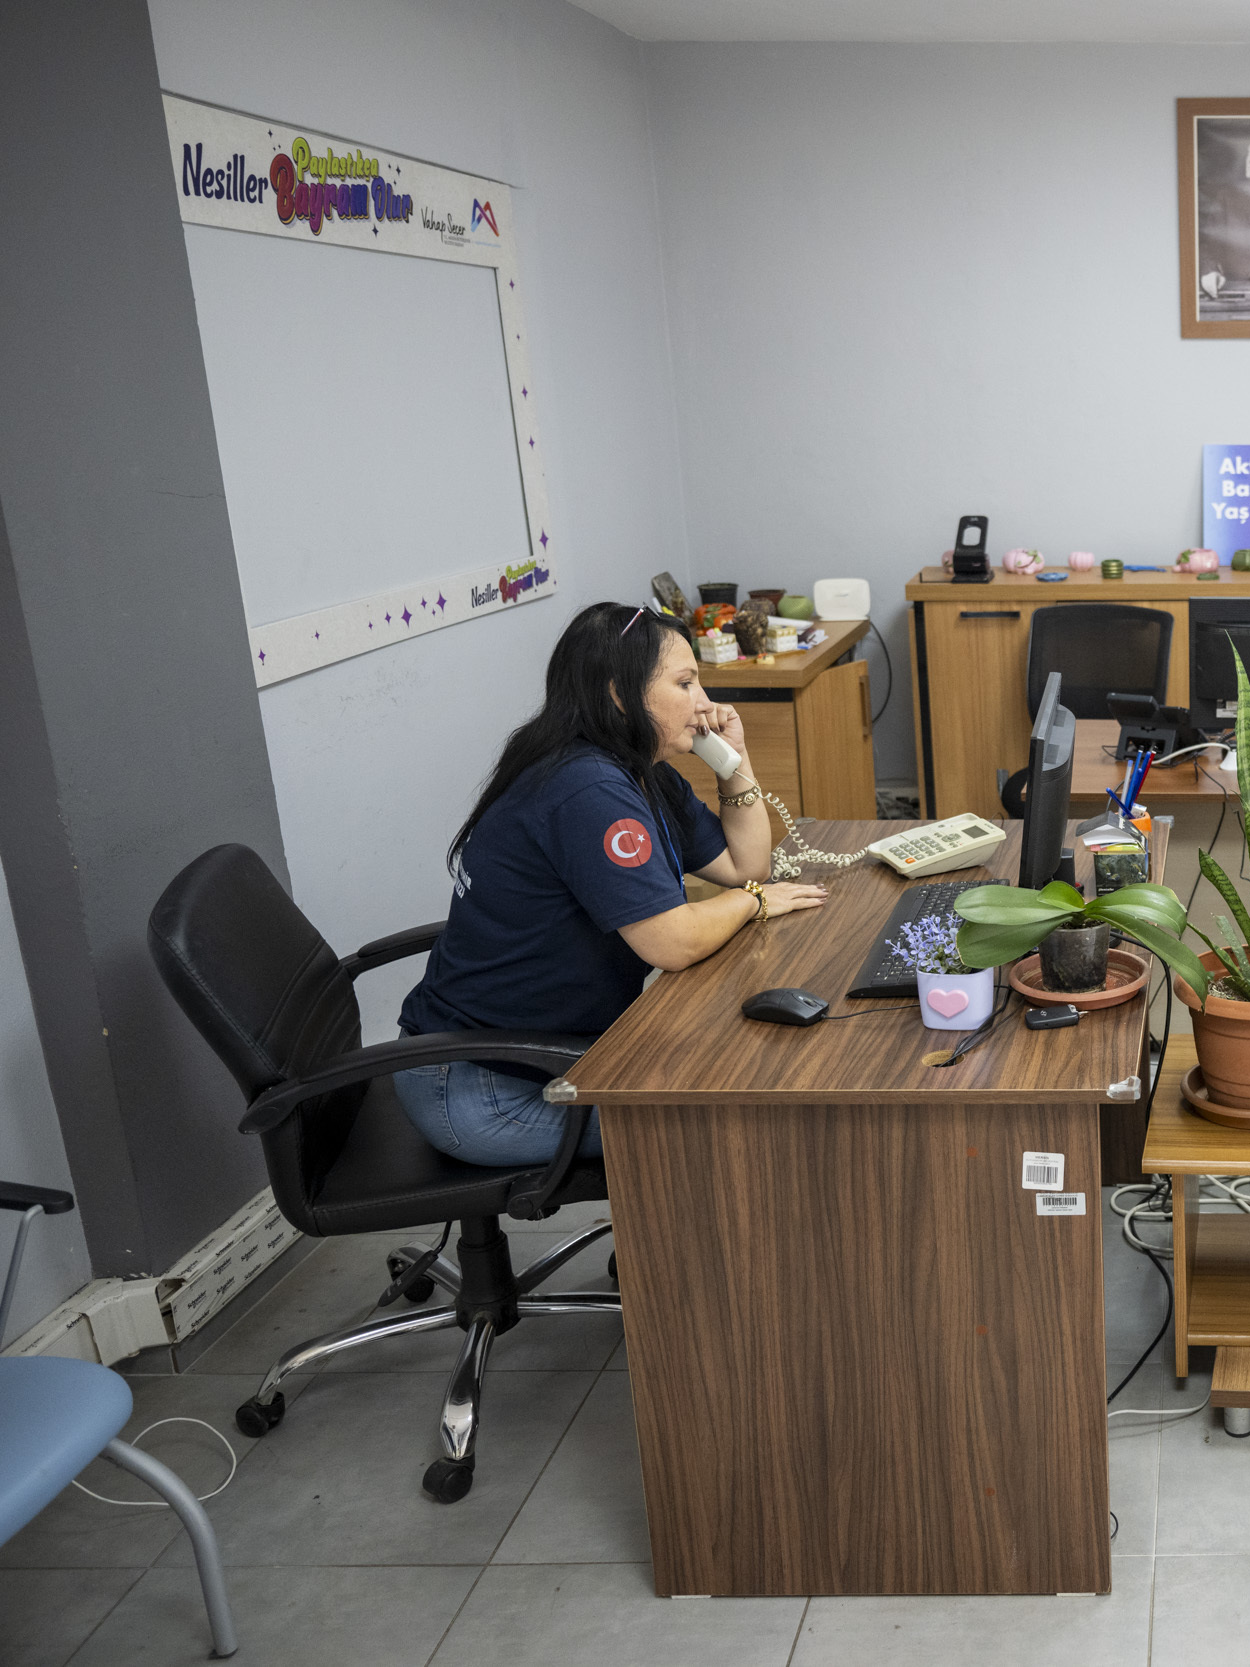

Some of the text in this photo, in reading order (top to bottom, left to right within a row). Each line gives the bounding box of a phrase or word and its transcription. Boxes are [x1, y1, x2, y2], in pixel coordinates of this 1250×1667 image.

[182, 142, 268, 204] Nesiller
[292, 136, 379, 185] Paylaştıkça
[270, 152, 413, 236] Bayram Olur
[421, 206, 446, 242] Vahap
[1211, 502, 1249, 524] Yaş
[471, 583, 499, 608] Nesiller
